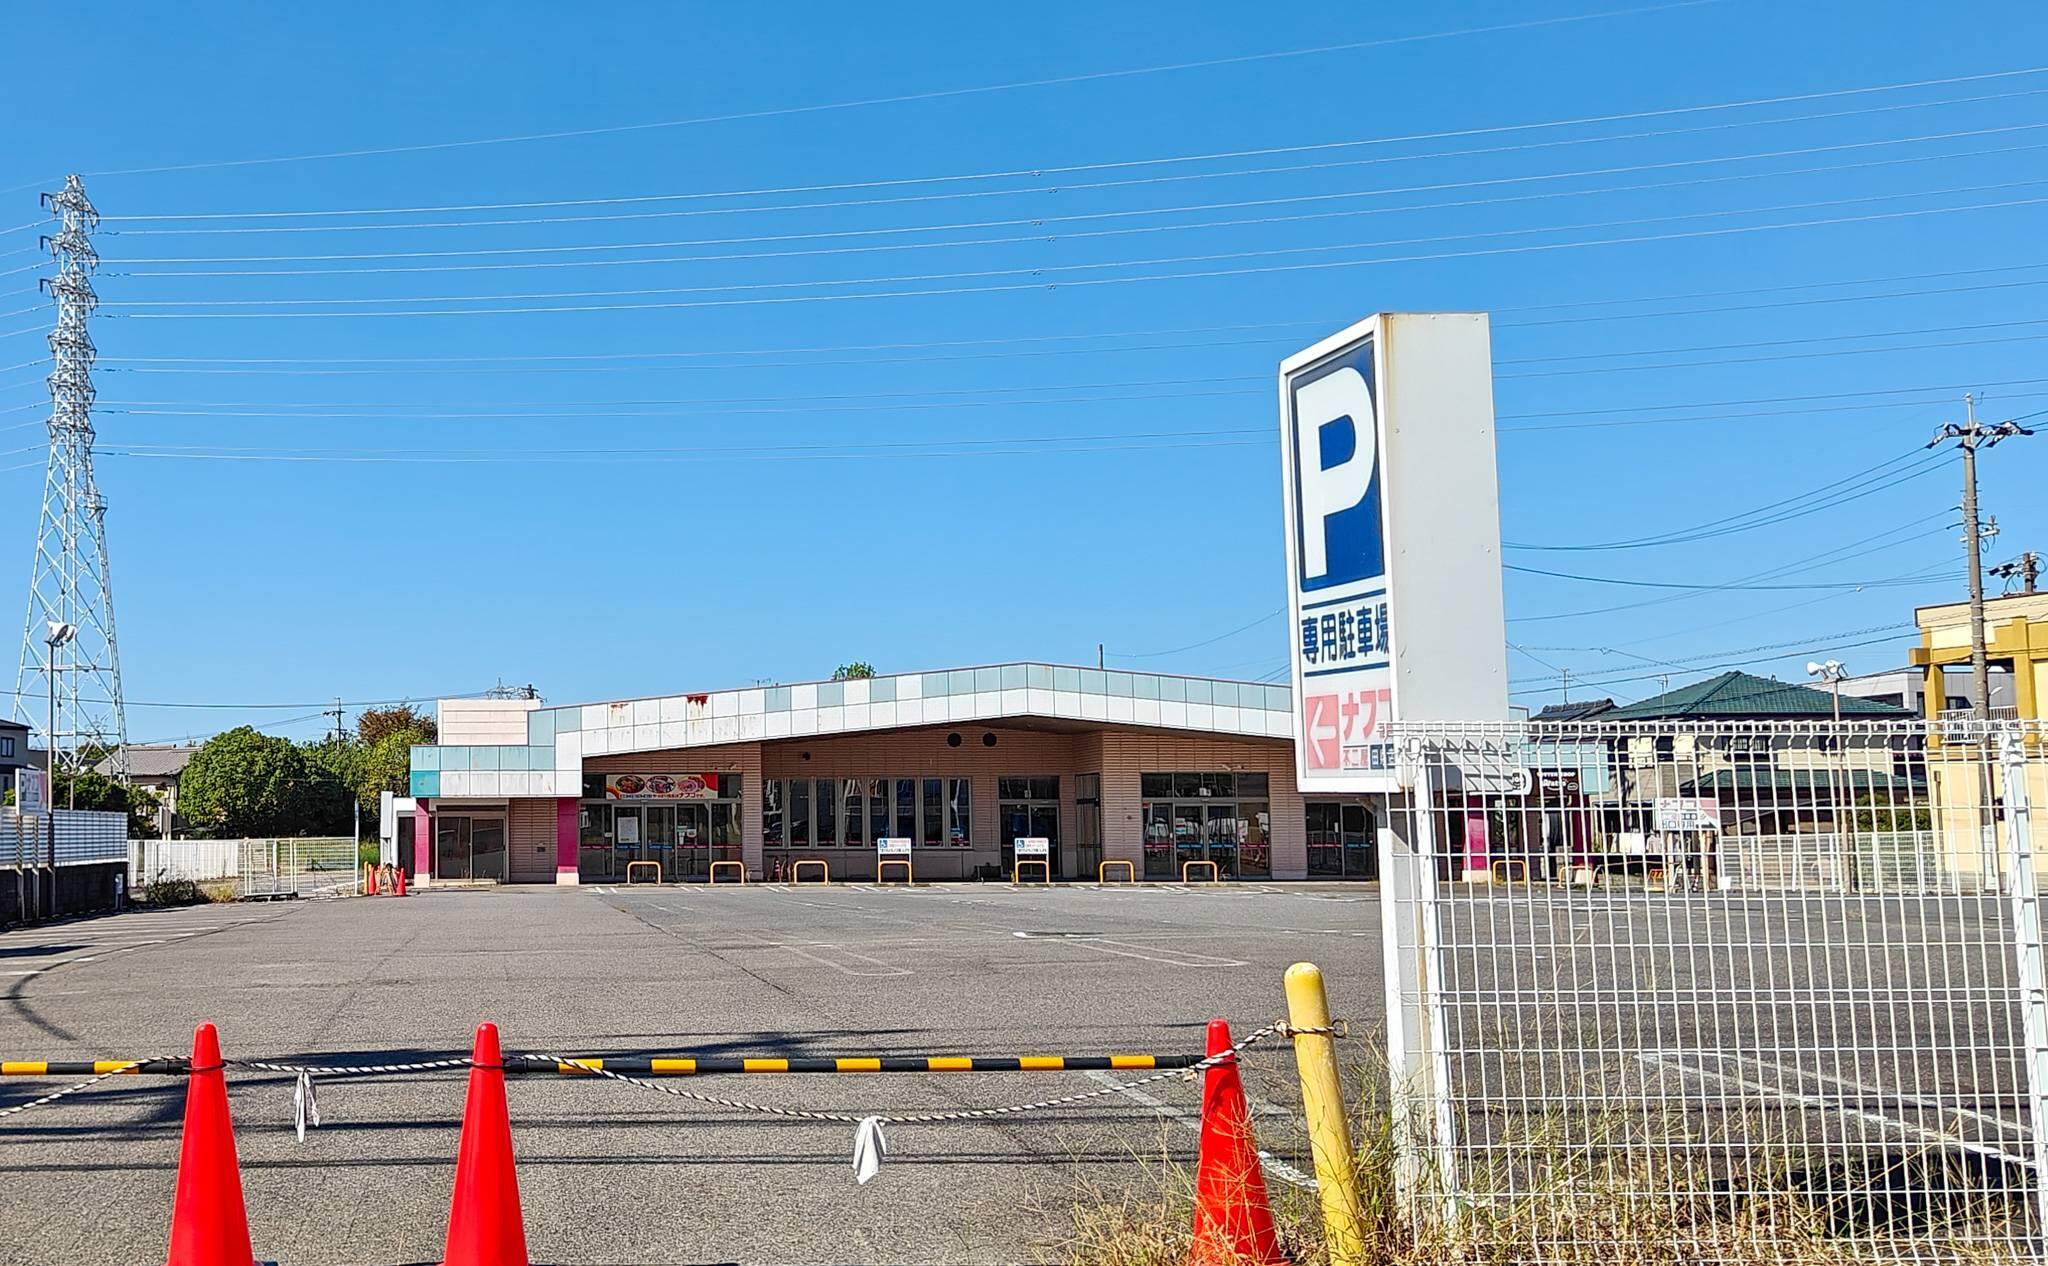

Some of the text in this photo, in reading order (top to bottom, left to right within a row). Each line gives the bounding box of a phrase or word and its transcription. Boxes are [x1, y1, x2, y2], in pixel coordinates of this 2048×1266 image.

[1295, 366, 1375, 580] P
[1301, 602, 1390, 664] 専用駐車場
